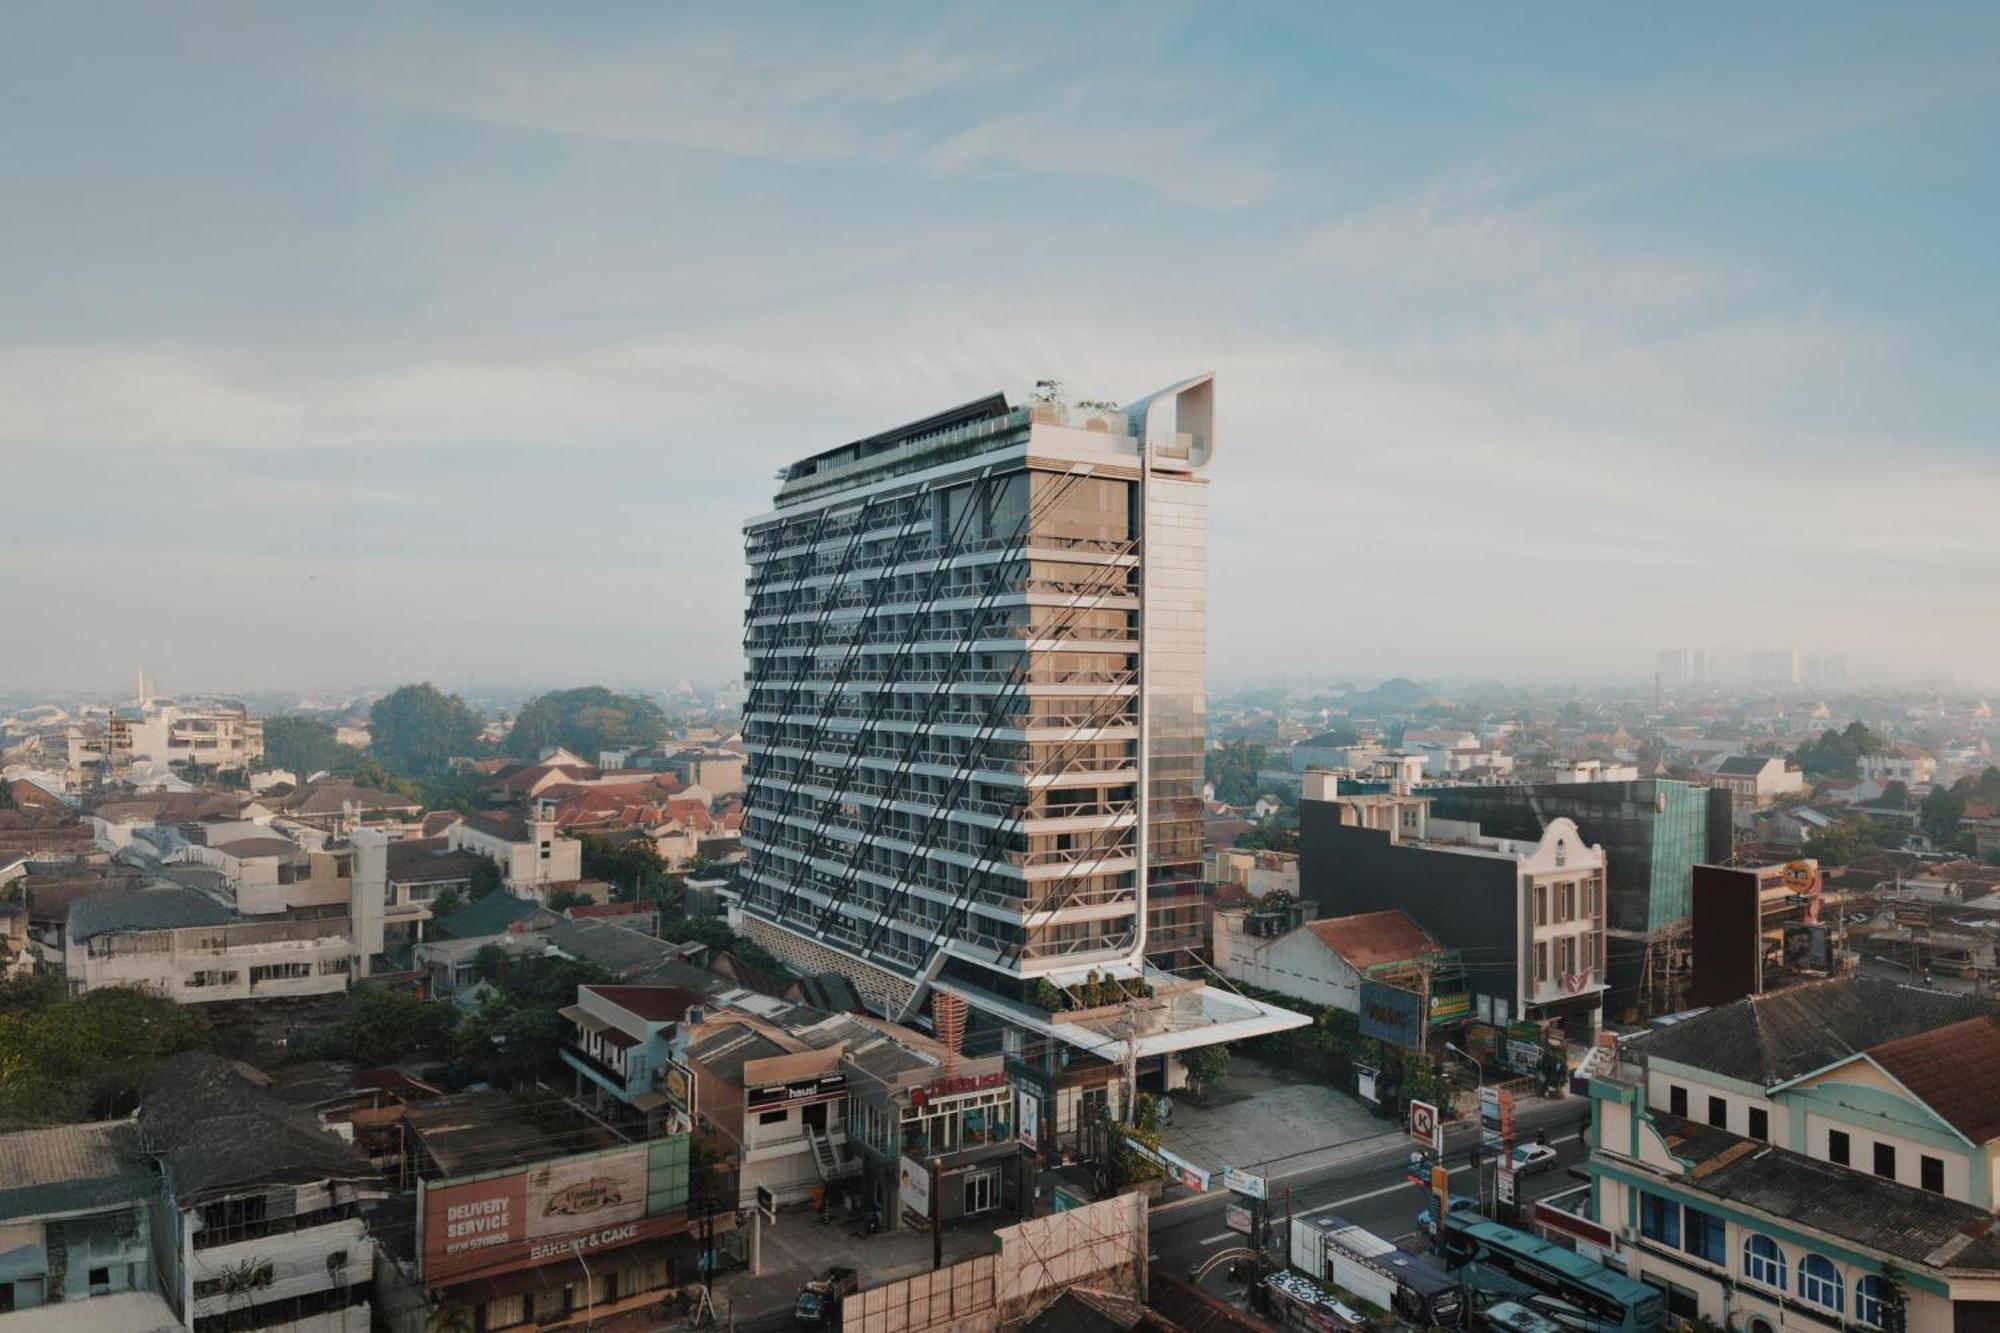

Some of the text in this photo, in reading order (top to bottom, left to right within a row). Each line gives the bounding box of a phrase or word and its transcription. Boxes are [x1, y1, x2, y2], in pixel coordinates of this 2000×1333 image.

[789, 1084, 817, 1099] haus!
[1418, 1113, 1430, 1133] K
[447, 1197, 510, 1222] DELIVERY
[447, 1212, 511, 1238] SERVICE
[588, 1234, 599, 1247] &
[601, 1224, 639, 1243] CAKE
